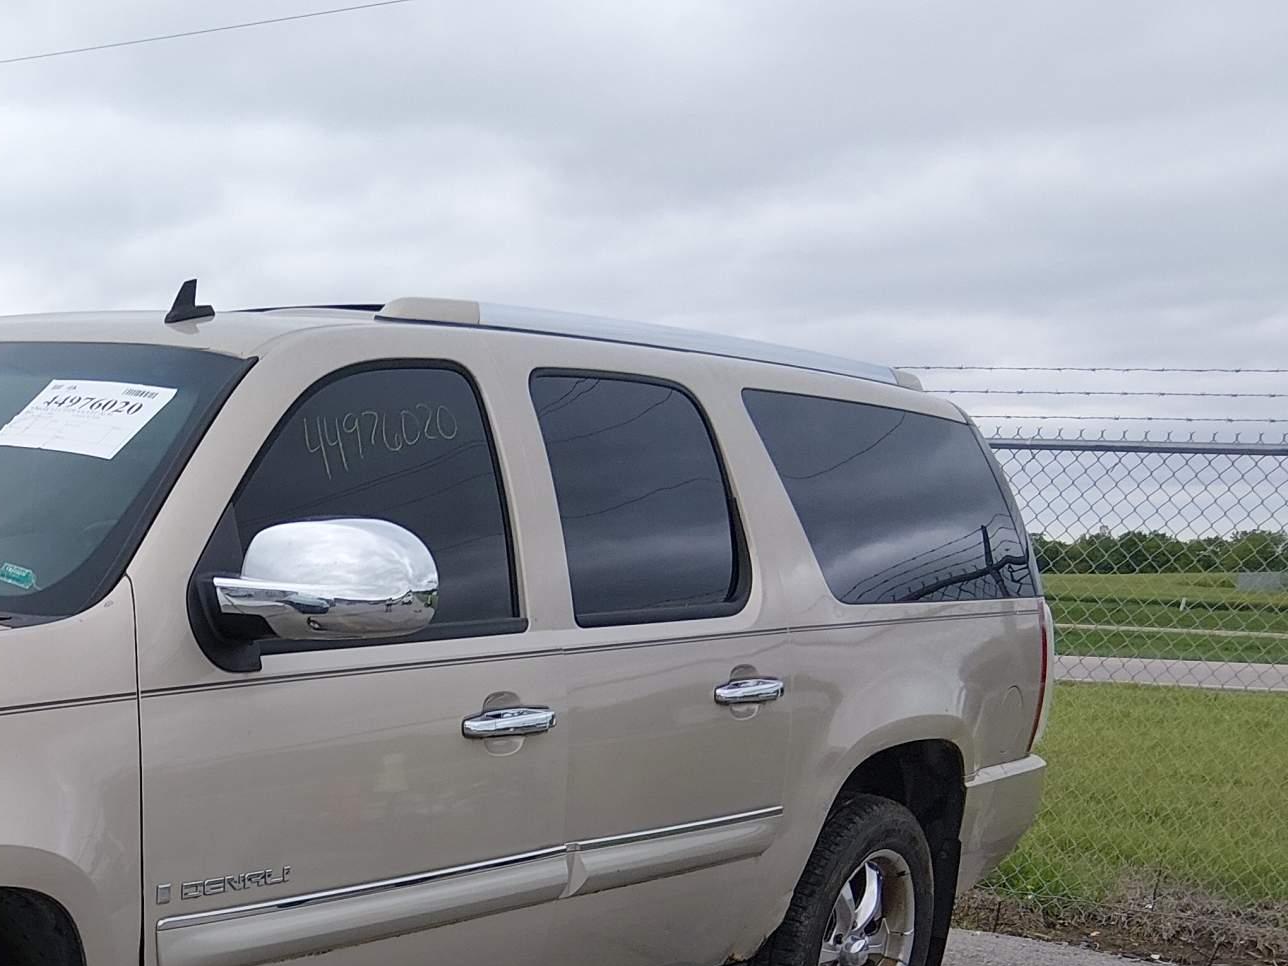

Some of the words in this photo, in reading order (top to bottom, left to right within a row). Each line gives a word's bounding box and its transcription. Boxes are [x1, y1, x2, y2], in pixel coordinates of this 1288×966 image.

[43, 395, 143, 415] 44976020
[303, 403, 458, 480] 44976020
[180, 865, 291, 900] DENALI
